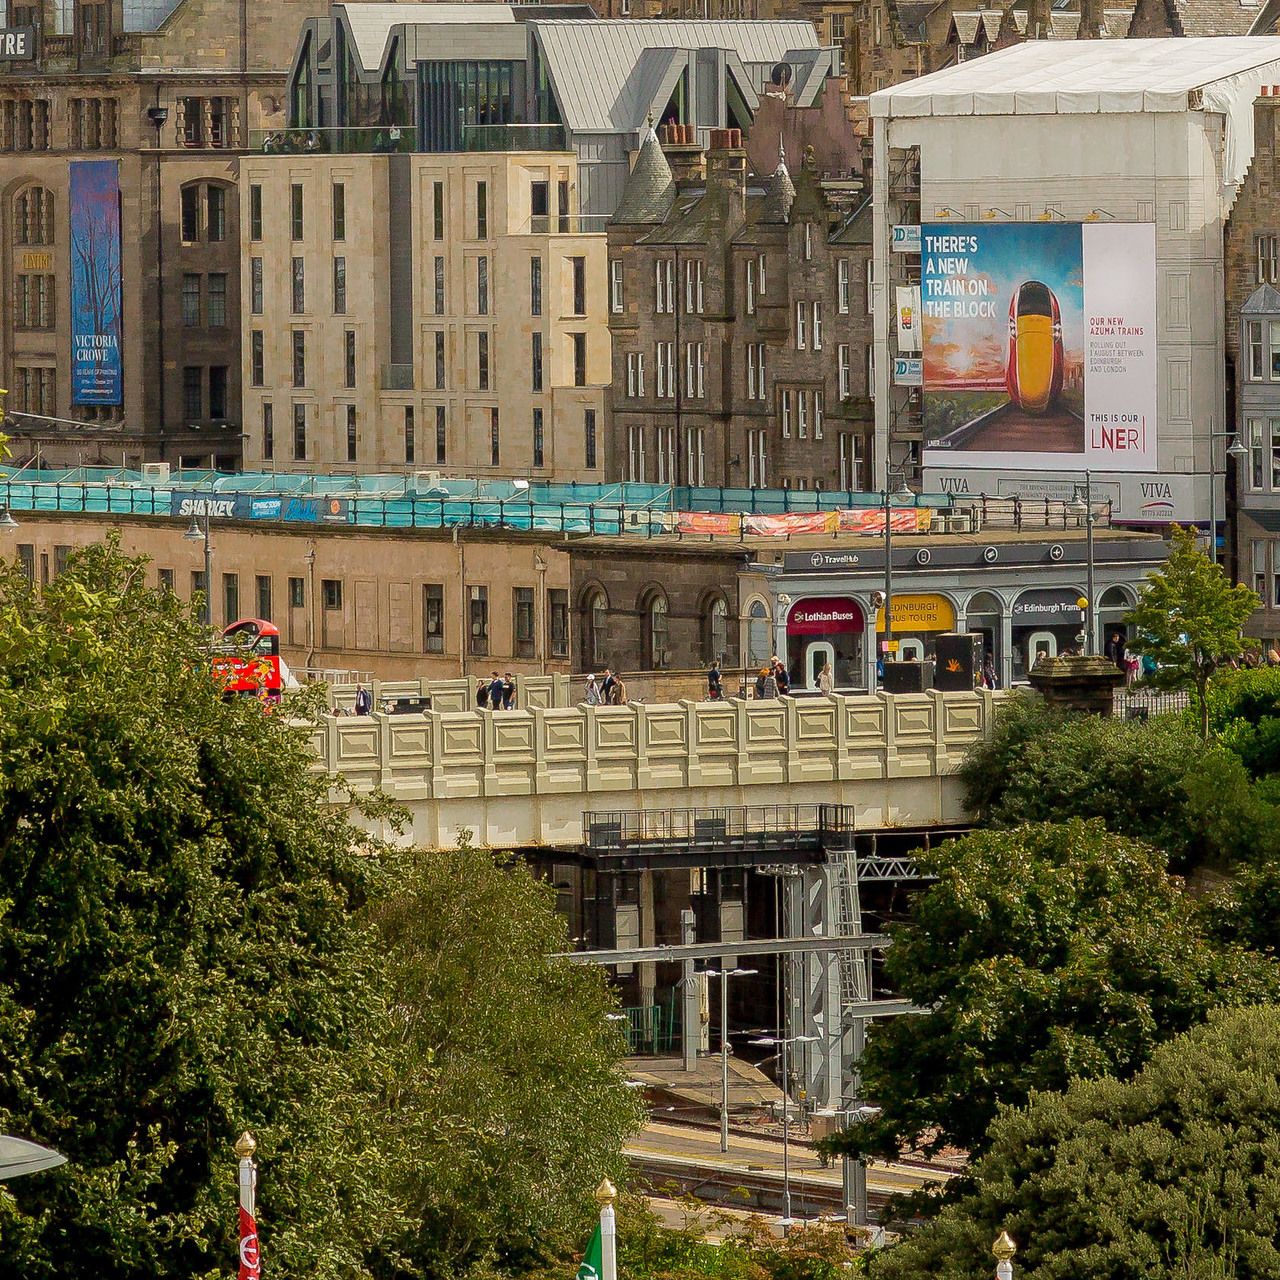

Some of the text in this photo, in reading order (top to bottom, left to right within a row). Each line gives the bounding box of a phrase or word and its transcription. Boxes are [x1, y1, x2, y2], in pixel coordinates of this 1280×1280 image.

[925, 236, 978, 253] THERE'S
[926, 257, 968, 274] A NEW
[926, 279, 988, 296] TRAIN ON
[926, 301, 996, 318] THE BLOCK
[1090, 317, 1124, 326] OUR NEW
[1090, 327, 1144, 336] AZUMA TRAINS
[75, 335, 118, 348] VICTORIA
[76, 349, 109, 361] CROWE
[1090, 413, 1139, 422] THIS IS OUR
[1091, 423, 1139, 453] LNER
[939, 477, 969, 493] VIVA
[1140, 482, 1172, 498] VIVA
[824, 554, 859, 564] TravelHub
[1024, 603, 1060, 613] Edinburgh
[805, 611, 854, 622] Lothian Buses
[909, 613, 937, 622] TOURS
